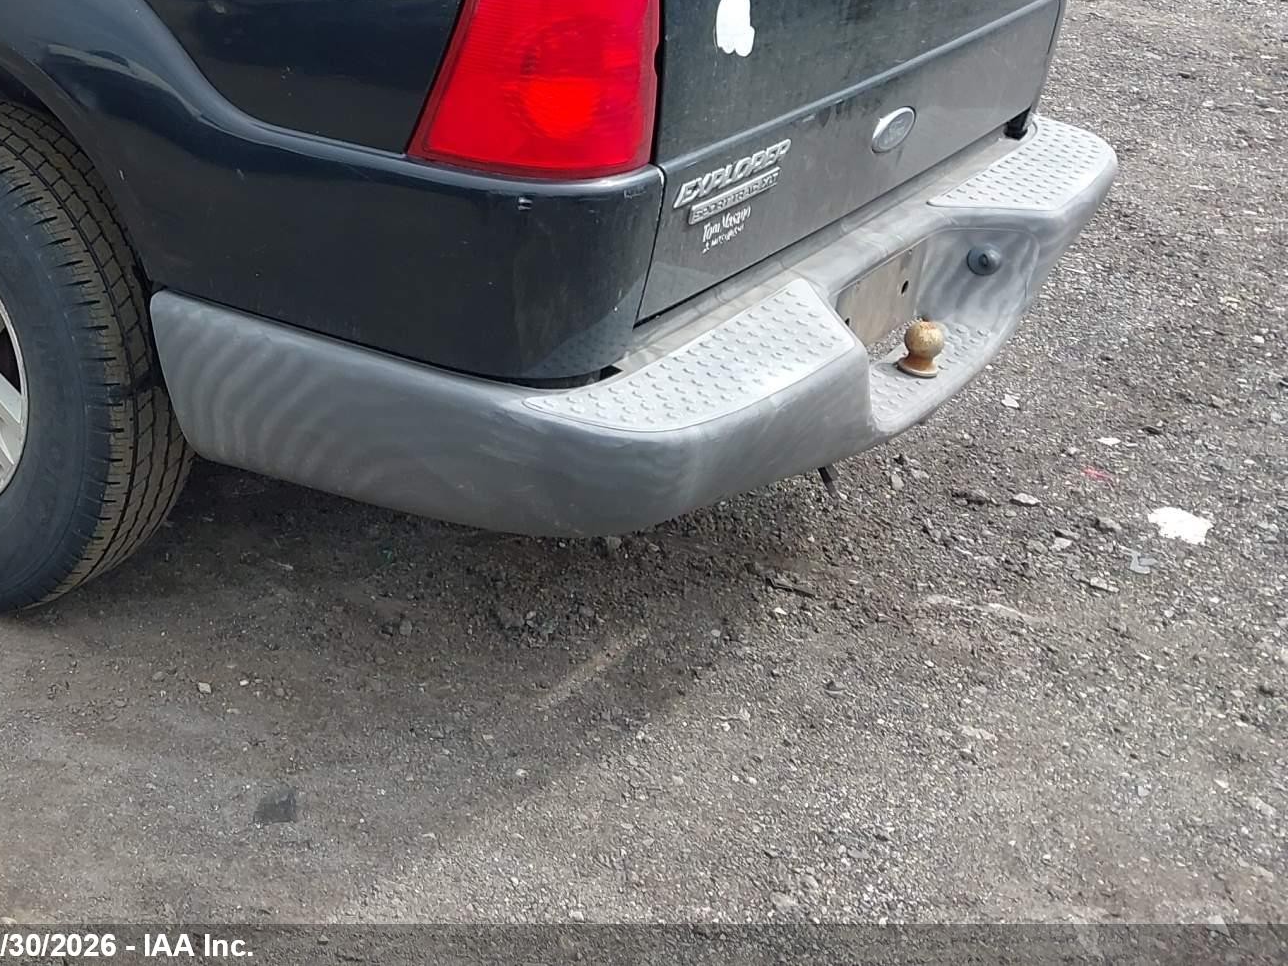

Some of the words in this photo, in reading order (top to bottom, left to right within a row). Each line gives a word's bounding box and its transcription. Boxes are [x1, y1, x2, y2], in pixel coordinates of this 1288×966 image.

[672, 138, 792, 209] EXPLORER
[691, 197, 731, 221] SPORT
[731, 184, 760, 202] TRAC
[759, 171, 779, 191] XLT
